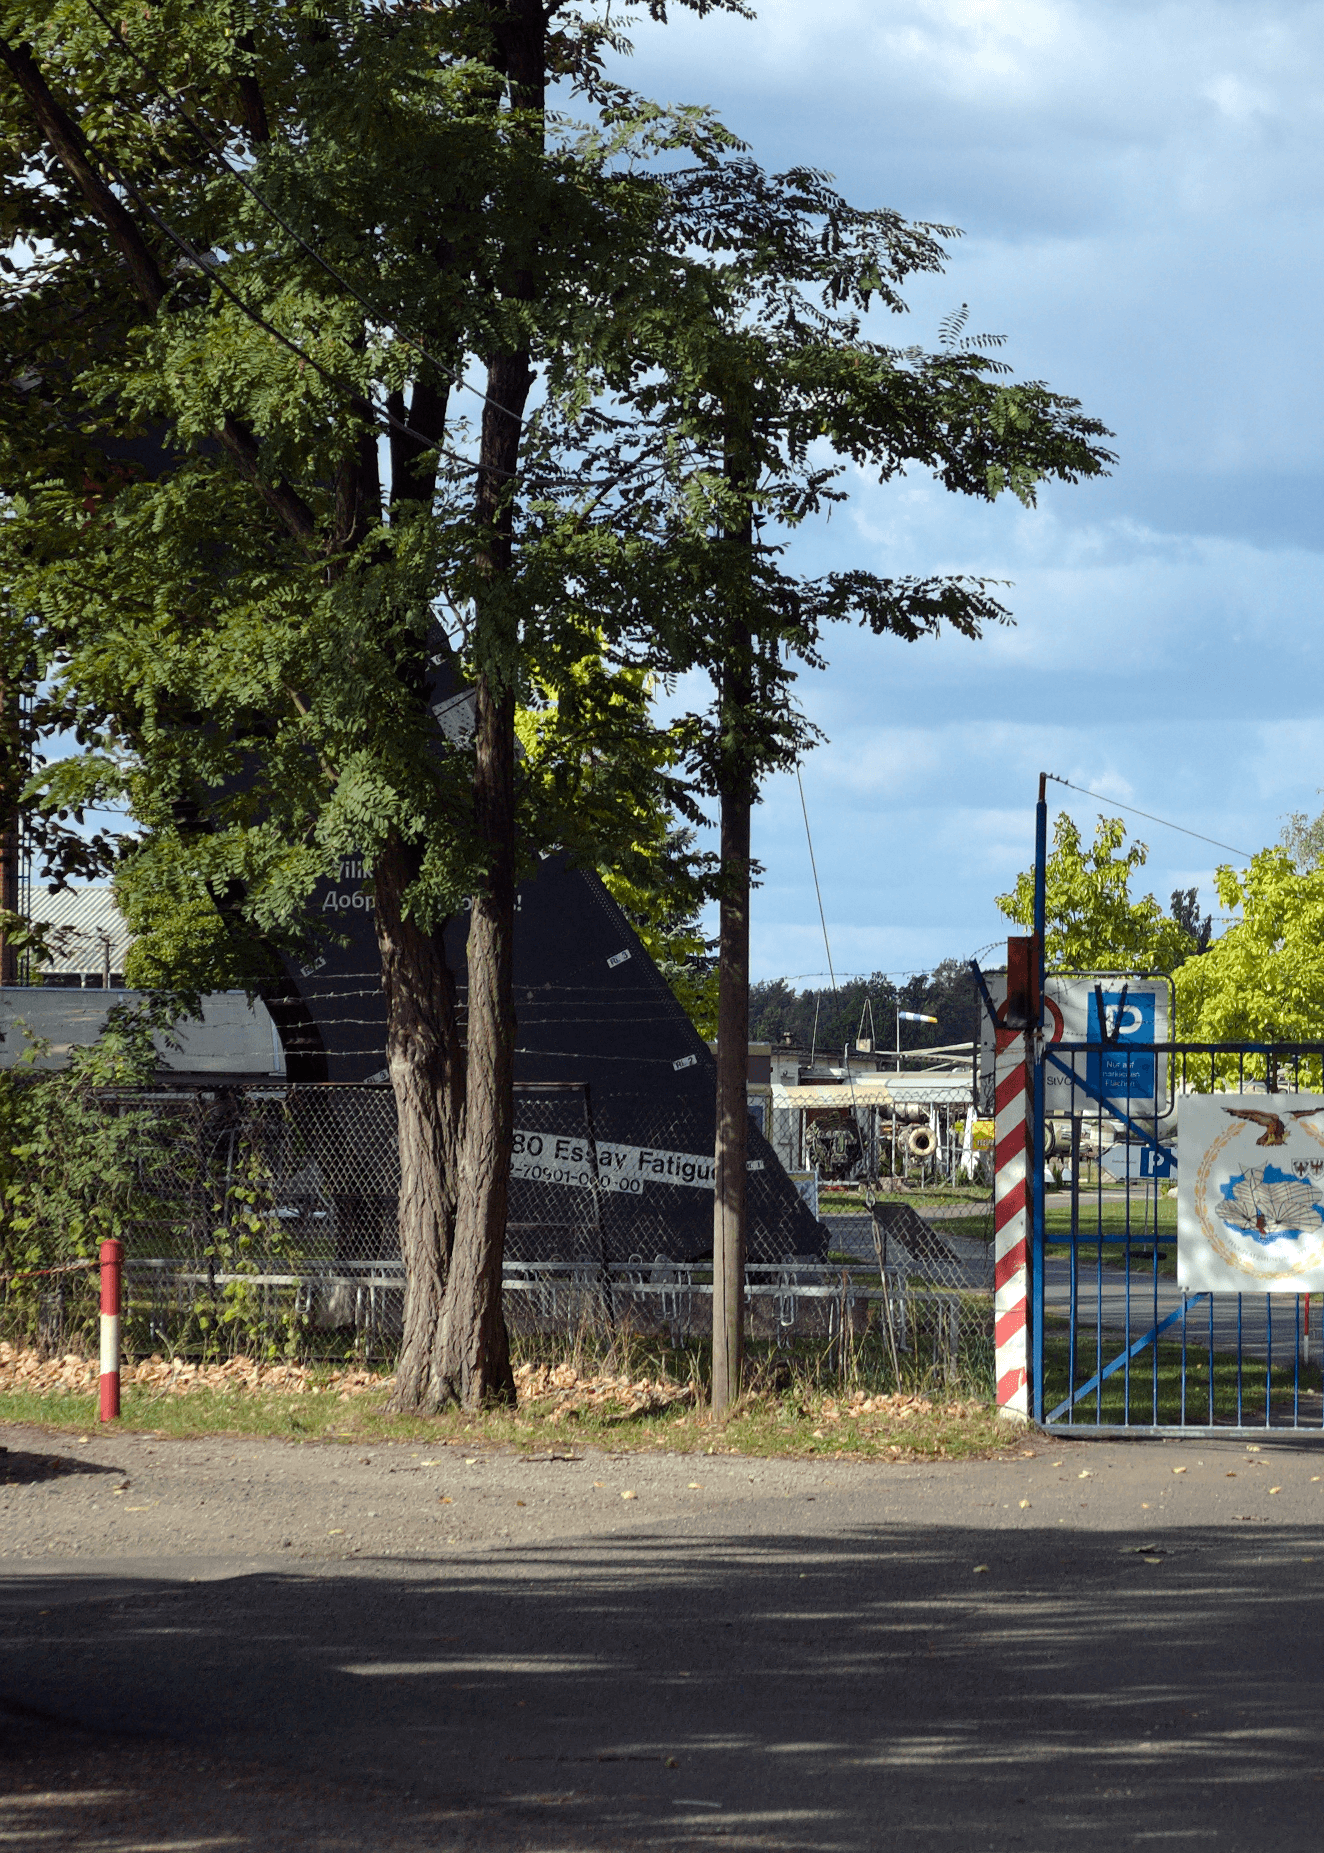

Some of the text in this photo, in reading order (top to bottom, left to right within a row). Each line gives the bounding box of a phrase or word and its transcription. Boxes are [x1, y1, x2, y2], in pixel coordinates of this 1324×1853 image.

[322, 890, 377, 912] Добр
[621, 951, 629, 960] 3
[1103, 1004, 1143, 1041] P
[1106, 1060, 1121, 1069] Nur
[1147, 1150, 1165, 1175] P
